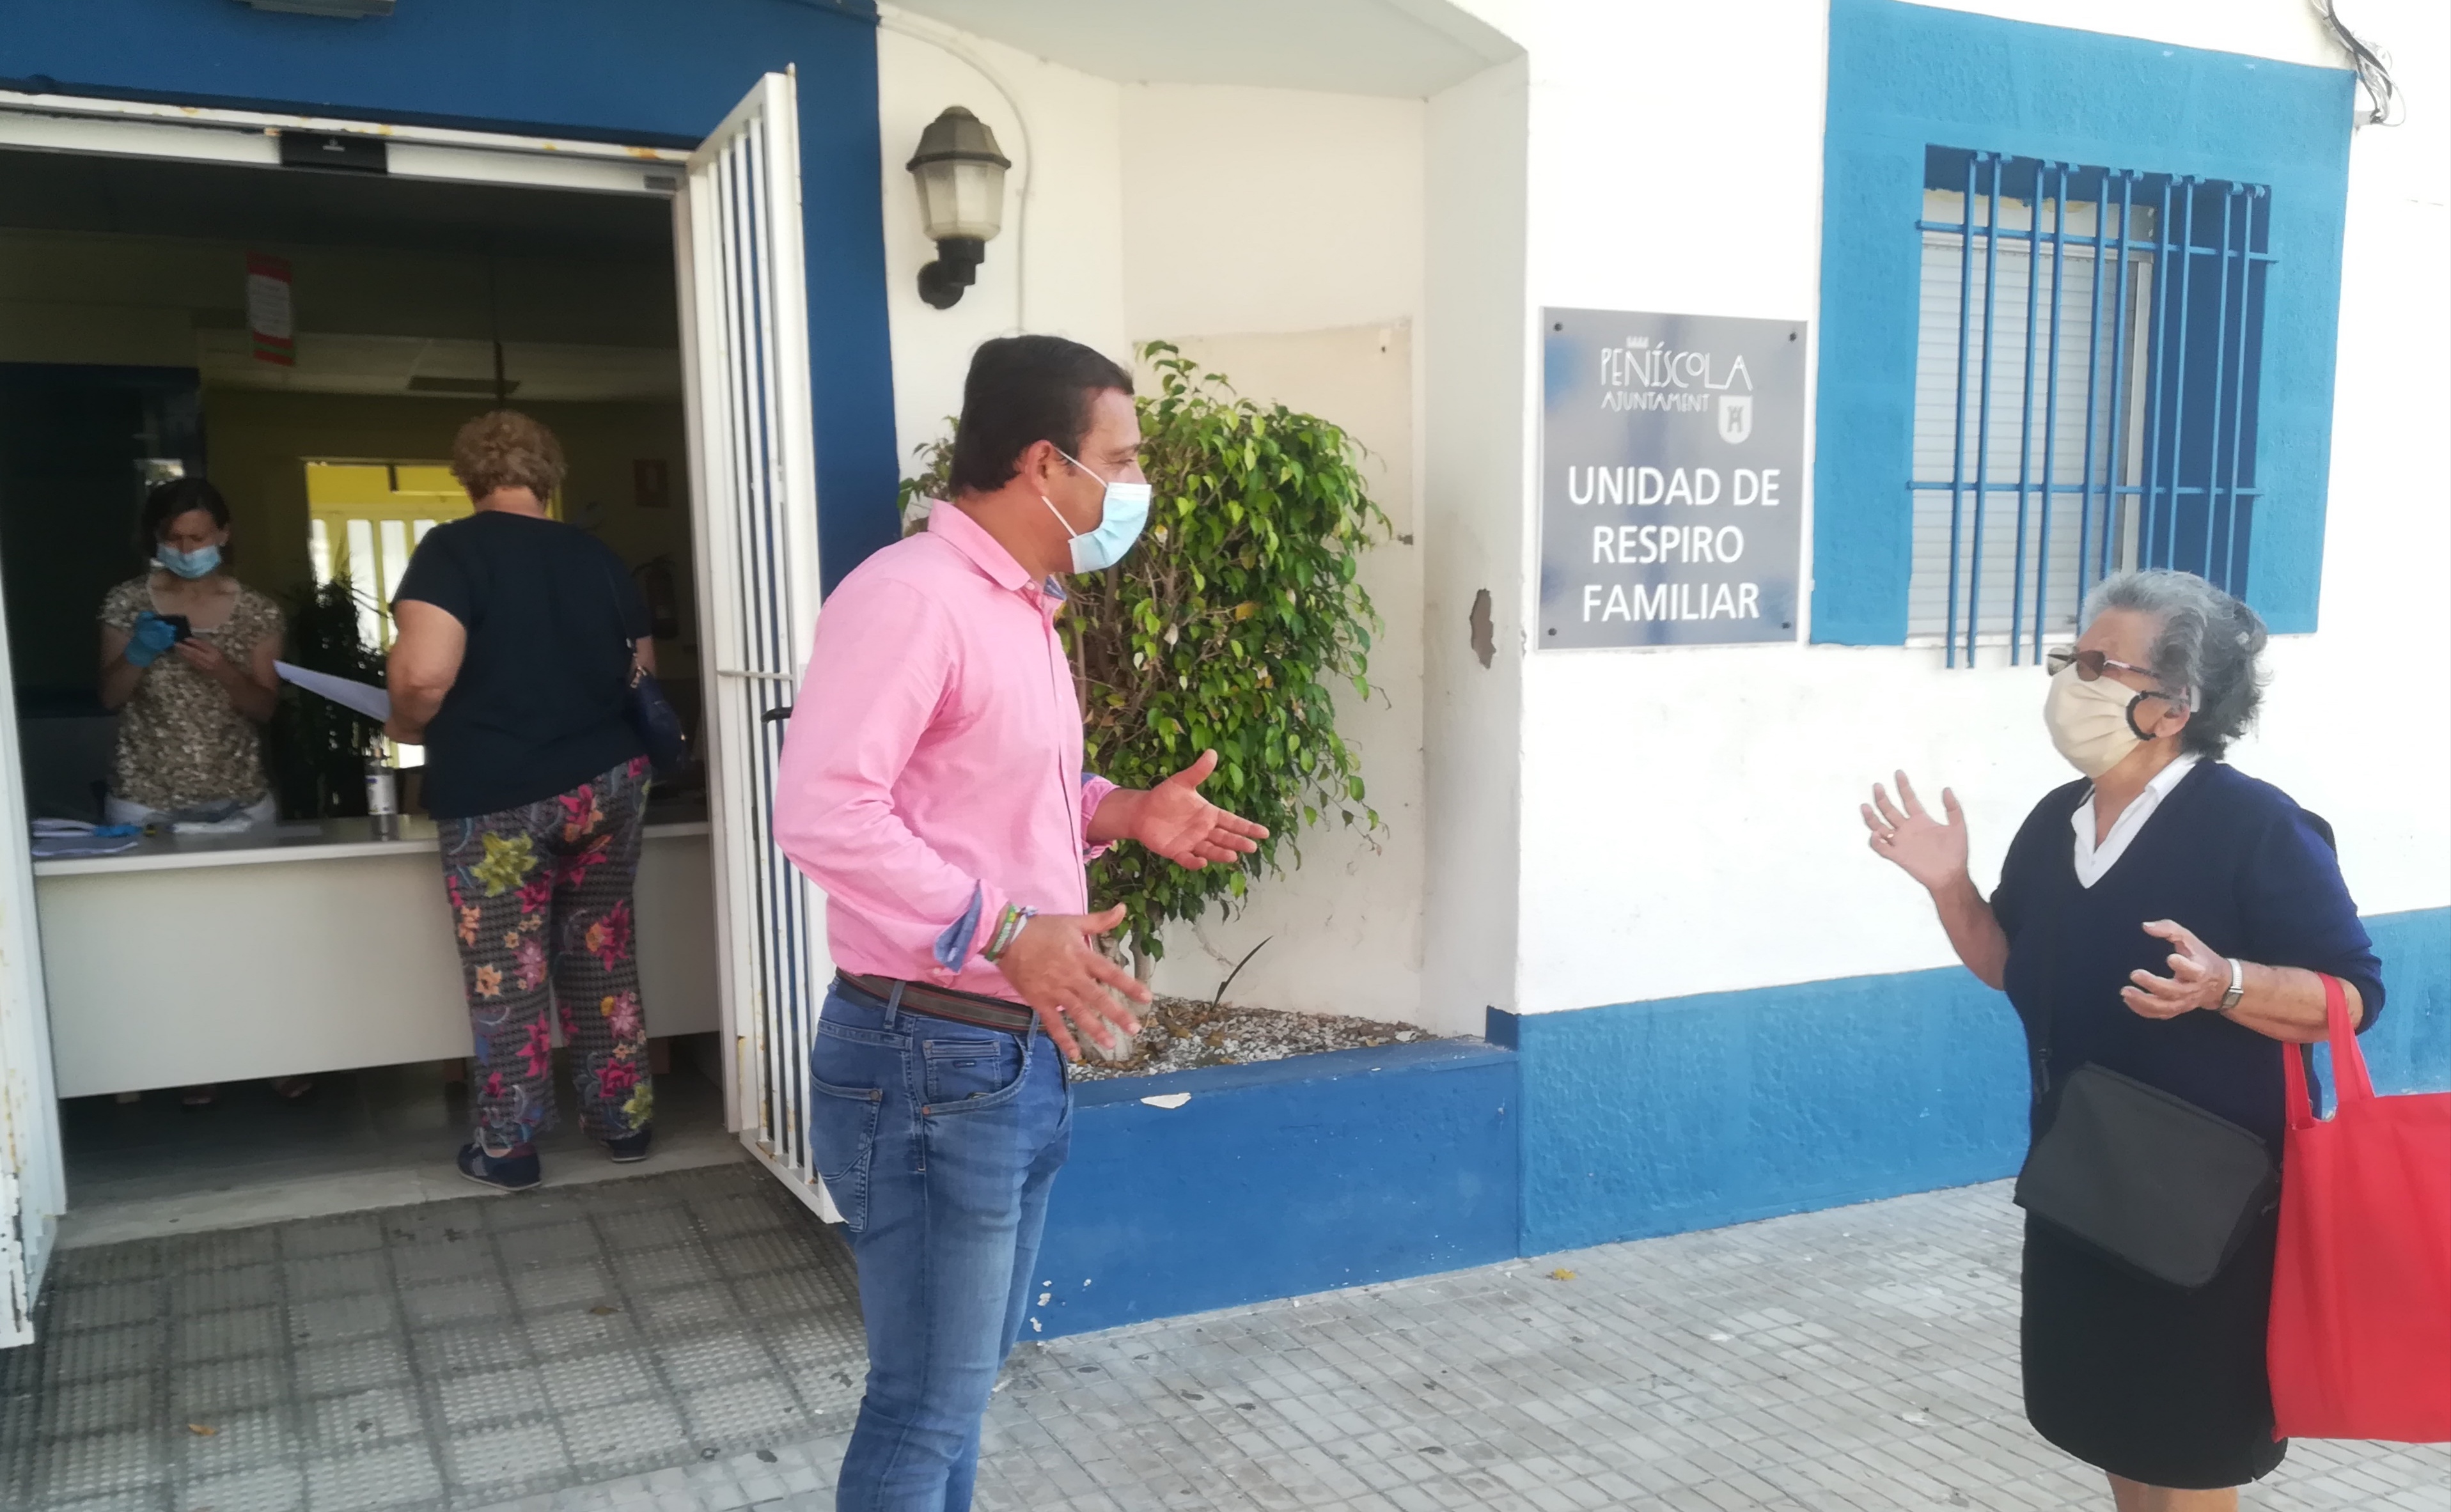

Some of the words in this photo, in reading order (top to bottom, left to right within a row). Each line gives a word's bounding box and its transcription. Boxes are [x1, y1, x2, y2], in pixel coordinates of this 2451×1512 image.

[1600, 390, 1711, 413] AJUNTAMENT
[1568, 465, 1721, 506] UNIDAD
[1732, 468, 1781, 506] DE
[1592, 525, 1745, 564] RESPIRO
[1582, 582, 1760, 623] FAMILIAR
